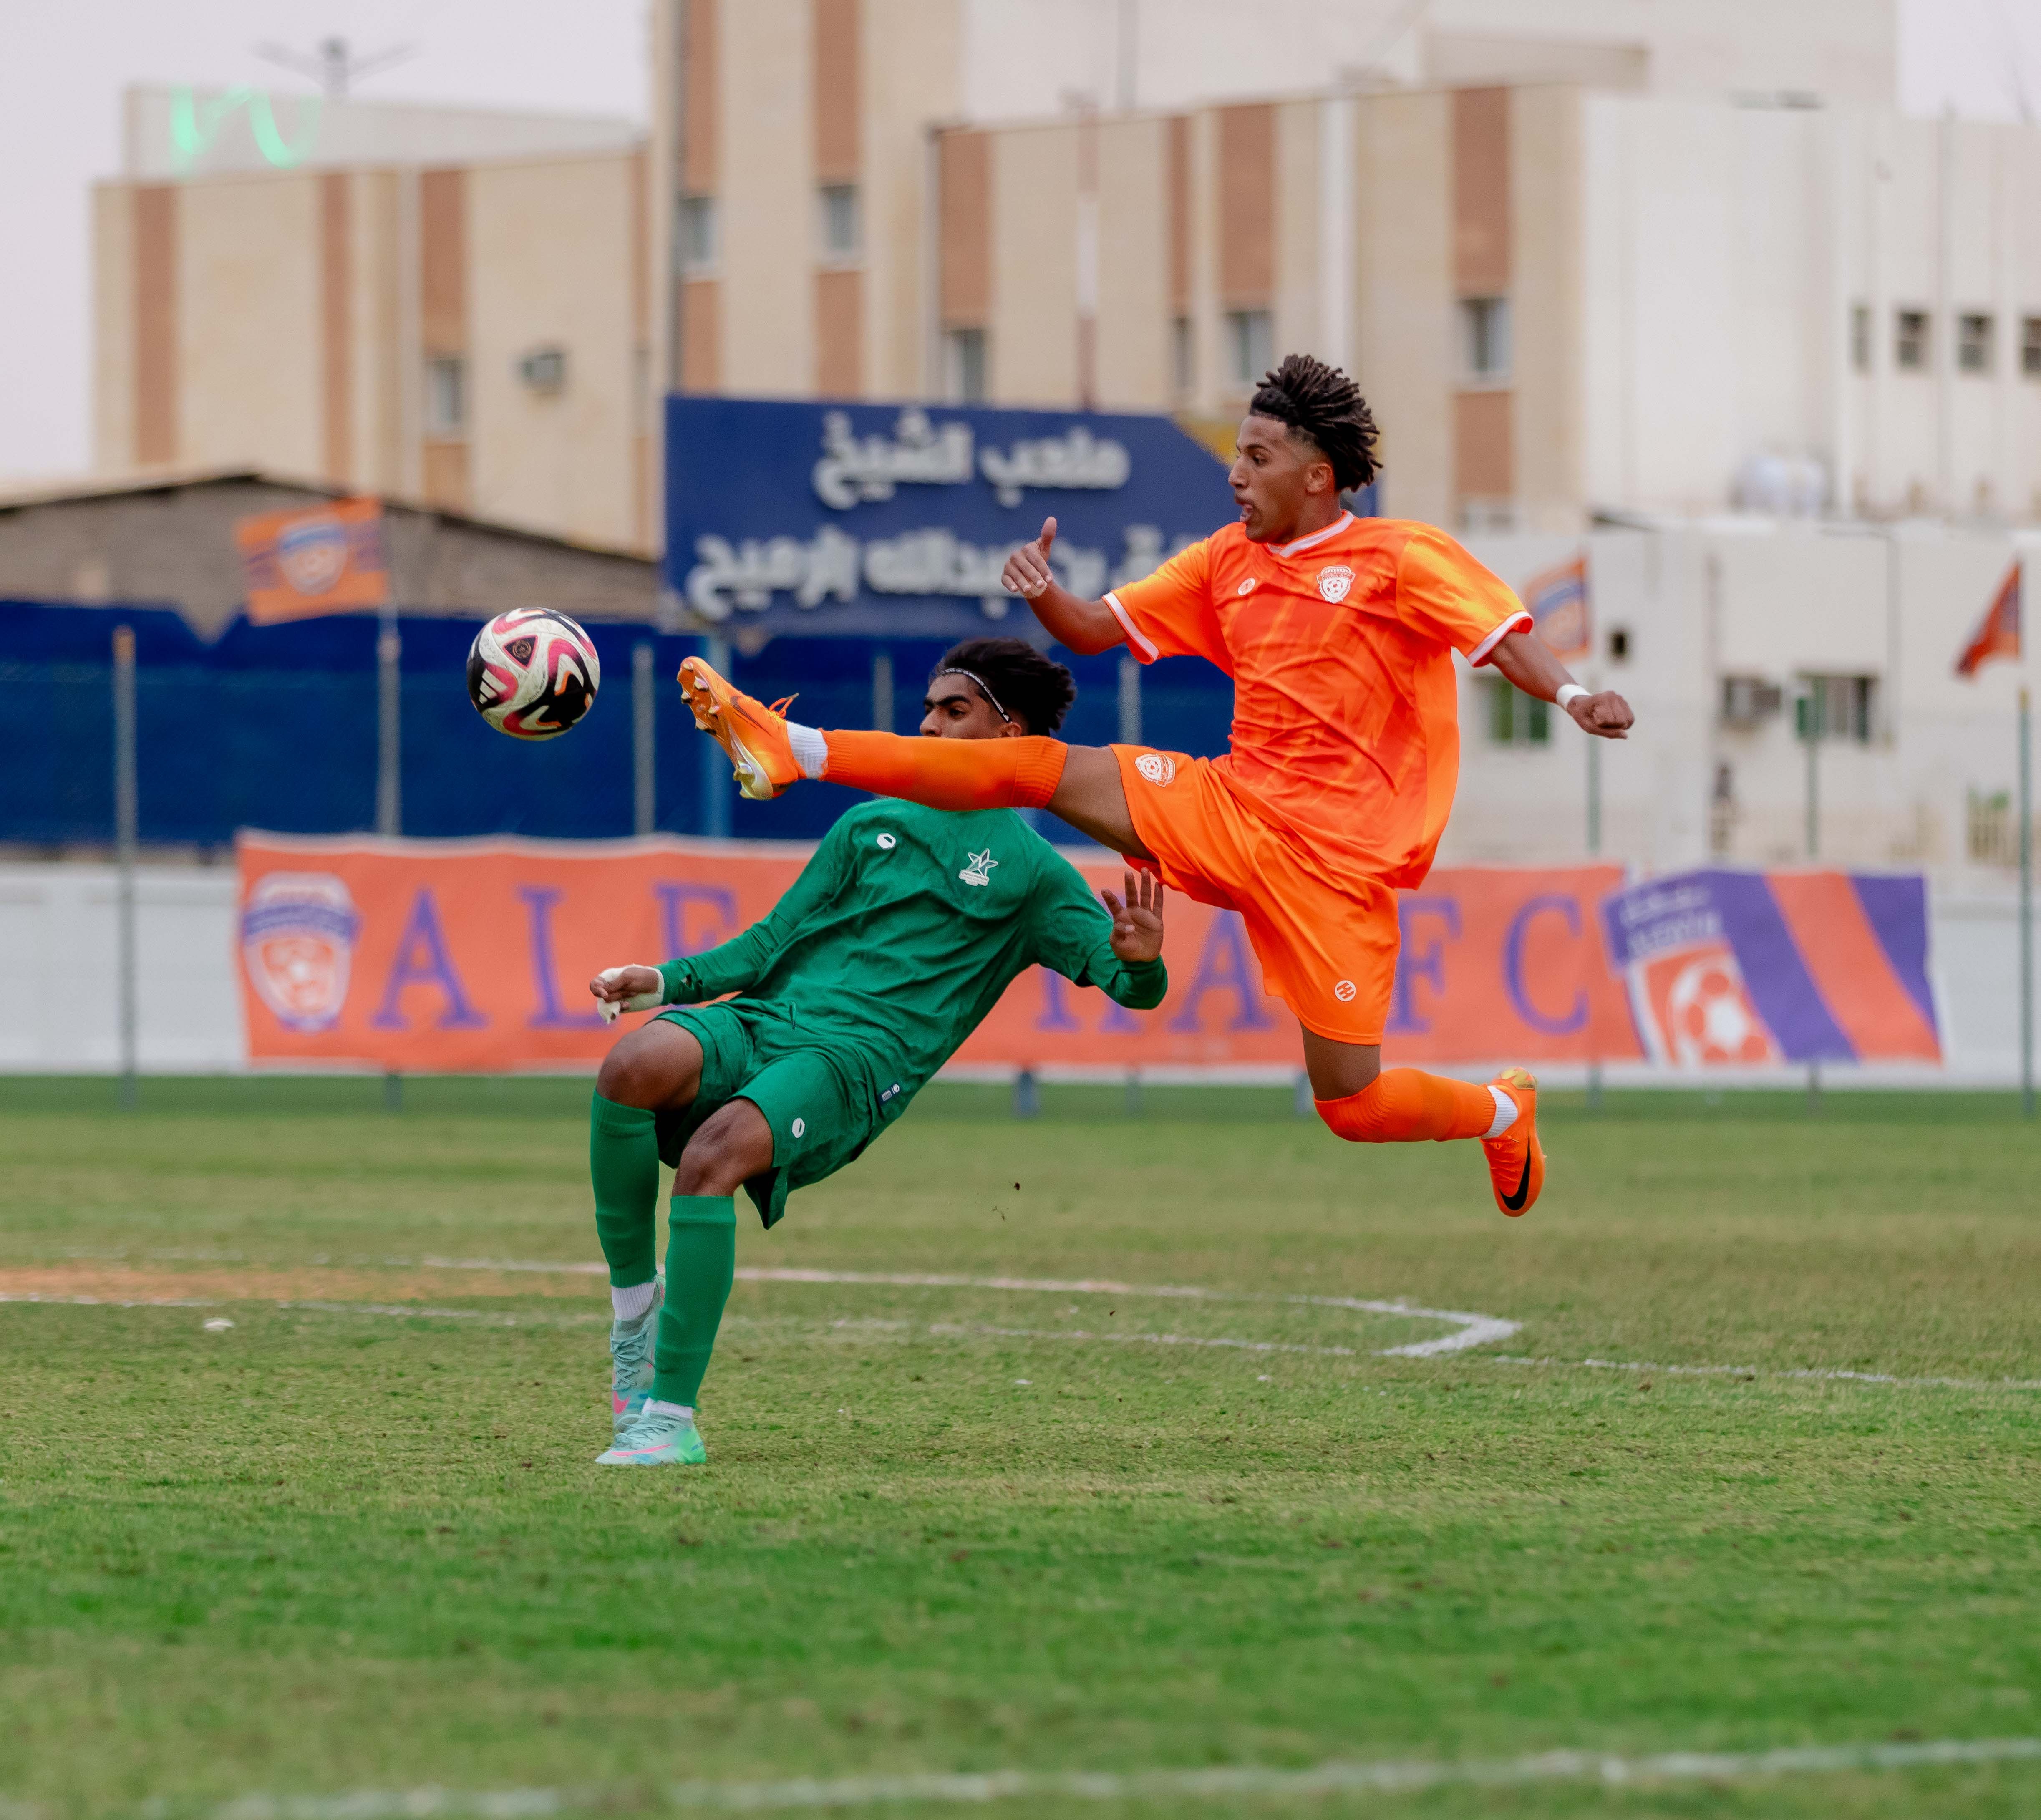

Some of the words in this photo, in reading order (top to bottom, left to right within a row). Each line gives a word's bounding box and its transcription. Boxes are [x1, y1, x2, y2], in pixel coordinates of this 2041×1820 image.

[811, 408, 974, 510] الشيخ
[979, 426, 1130, 508] ملعب
[866, 525, 1033, 620] بدالله
[1382, 893, 1590, 1036] FC
